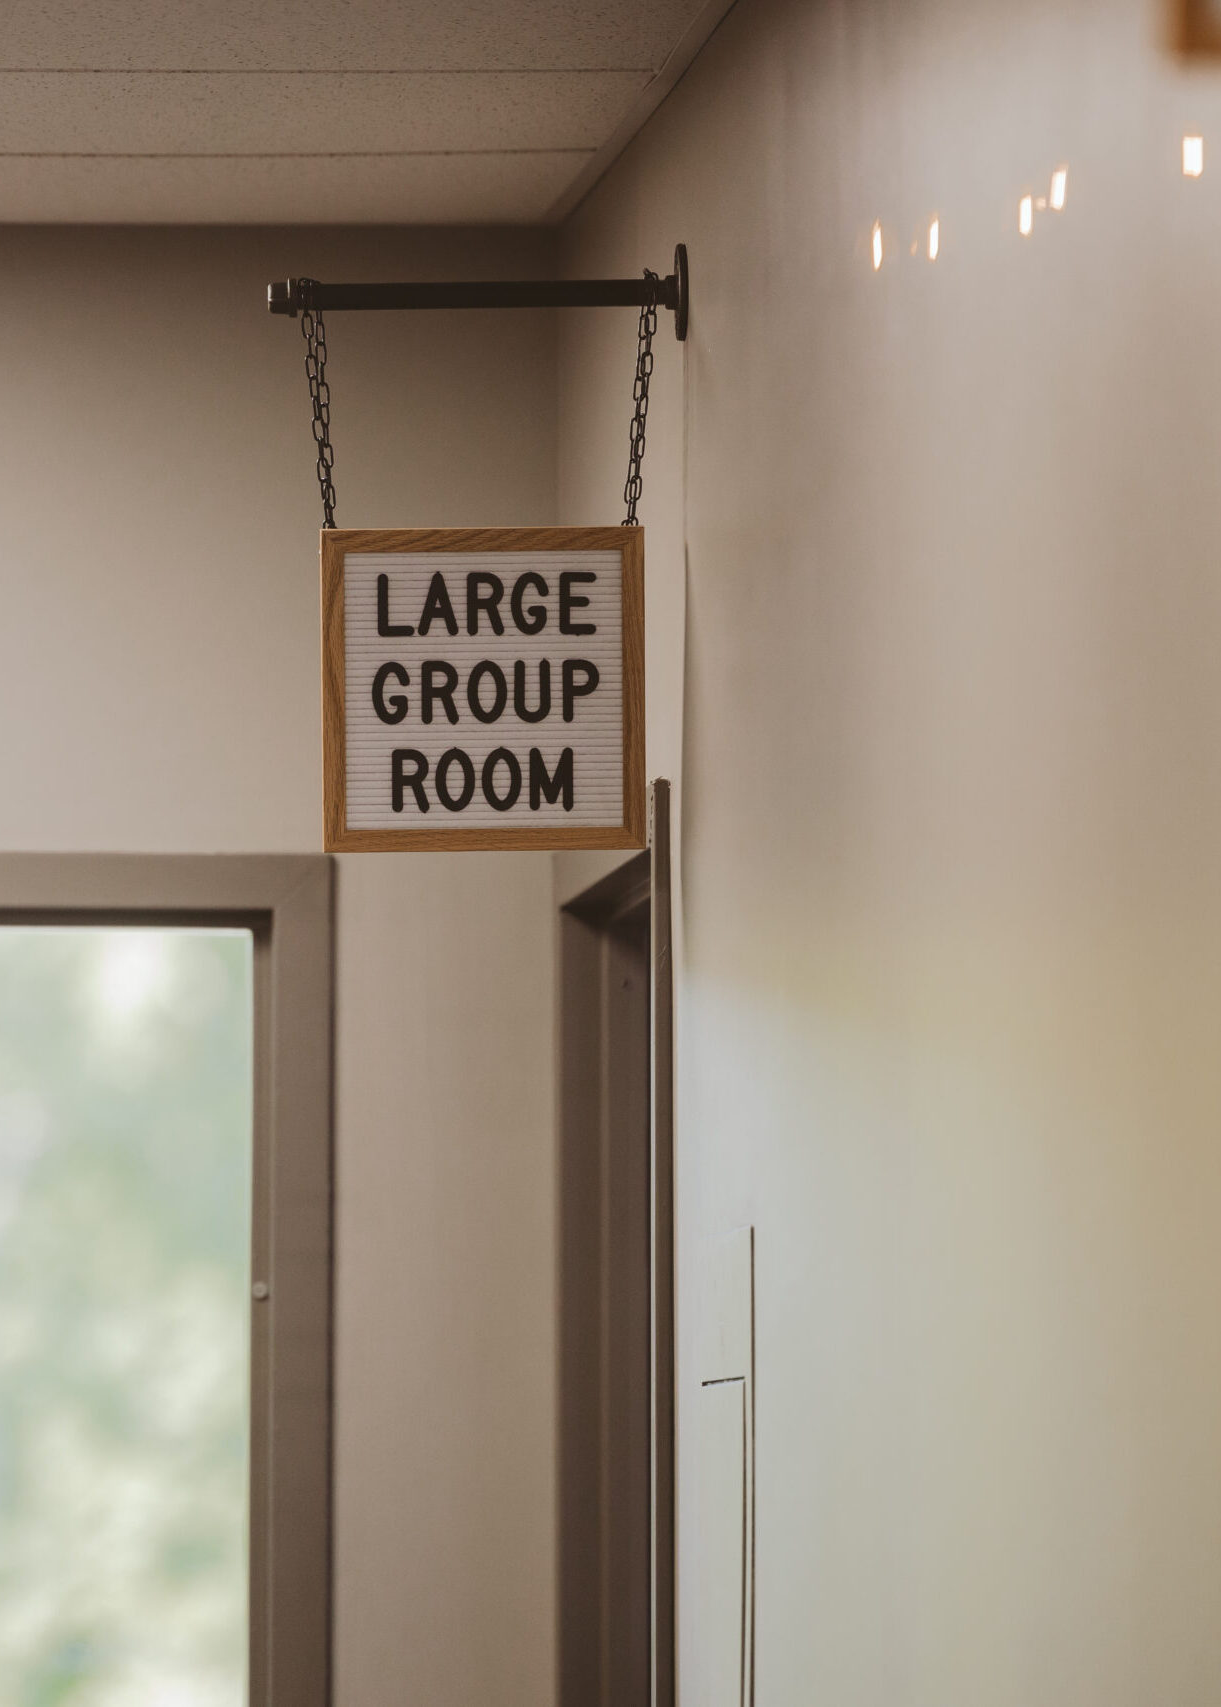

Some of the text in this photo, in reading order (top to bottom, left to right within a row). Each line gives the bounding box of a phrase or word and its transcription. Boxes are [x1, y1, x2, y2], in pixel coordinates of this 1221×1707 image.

[377, 571, 597, 637] LARGE
[371, 658, 600, 725] GROUP
[391, 747, 574, 813] ROOM
